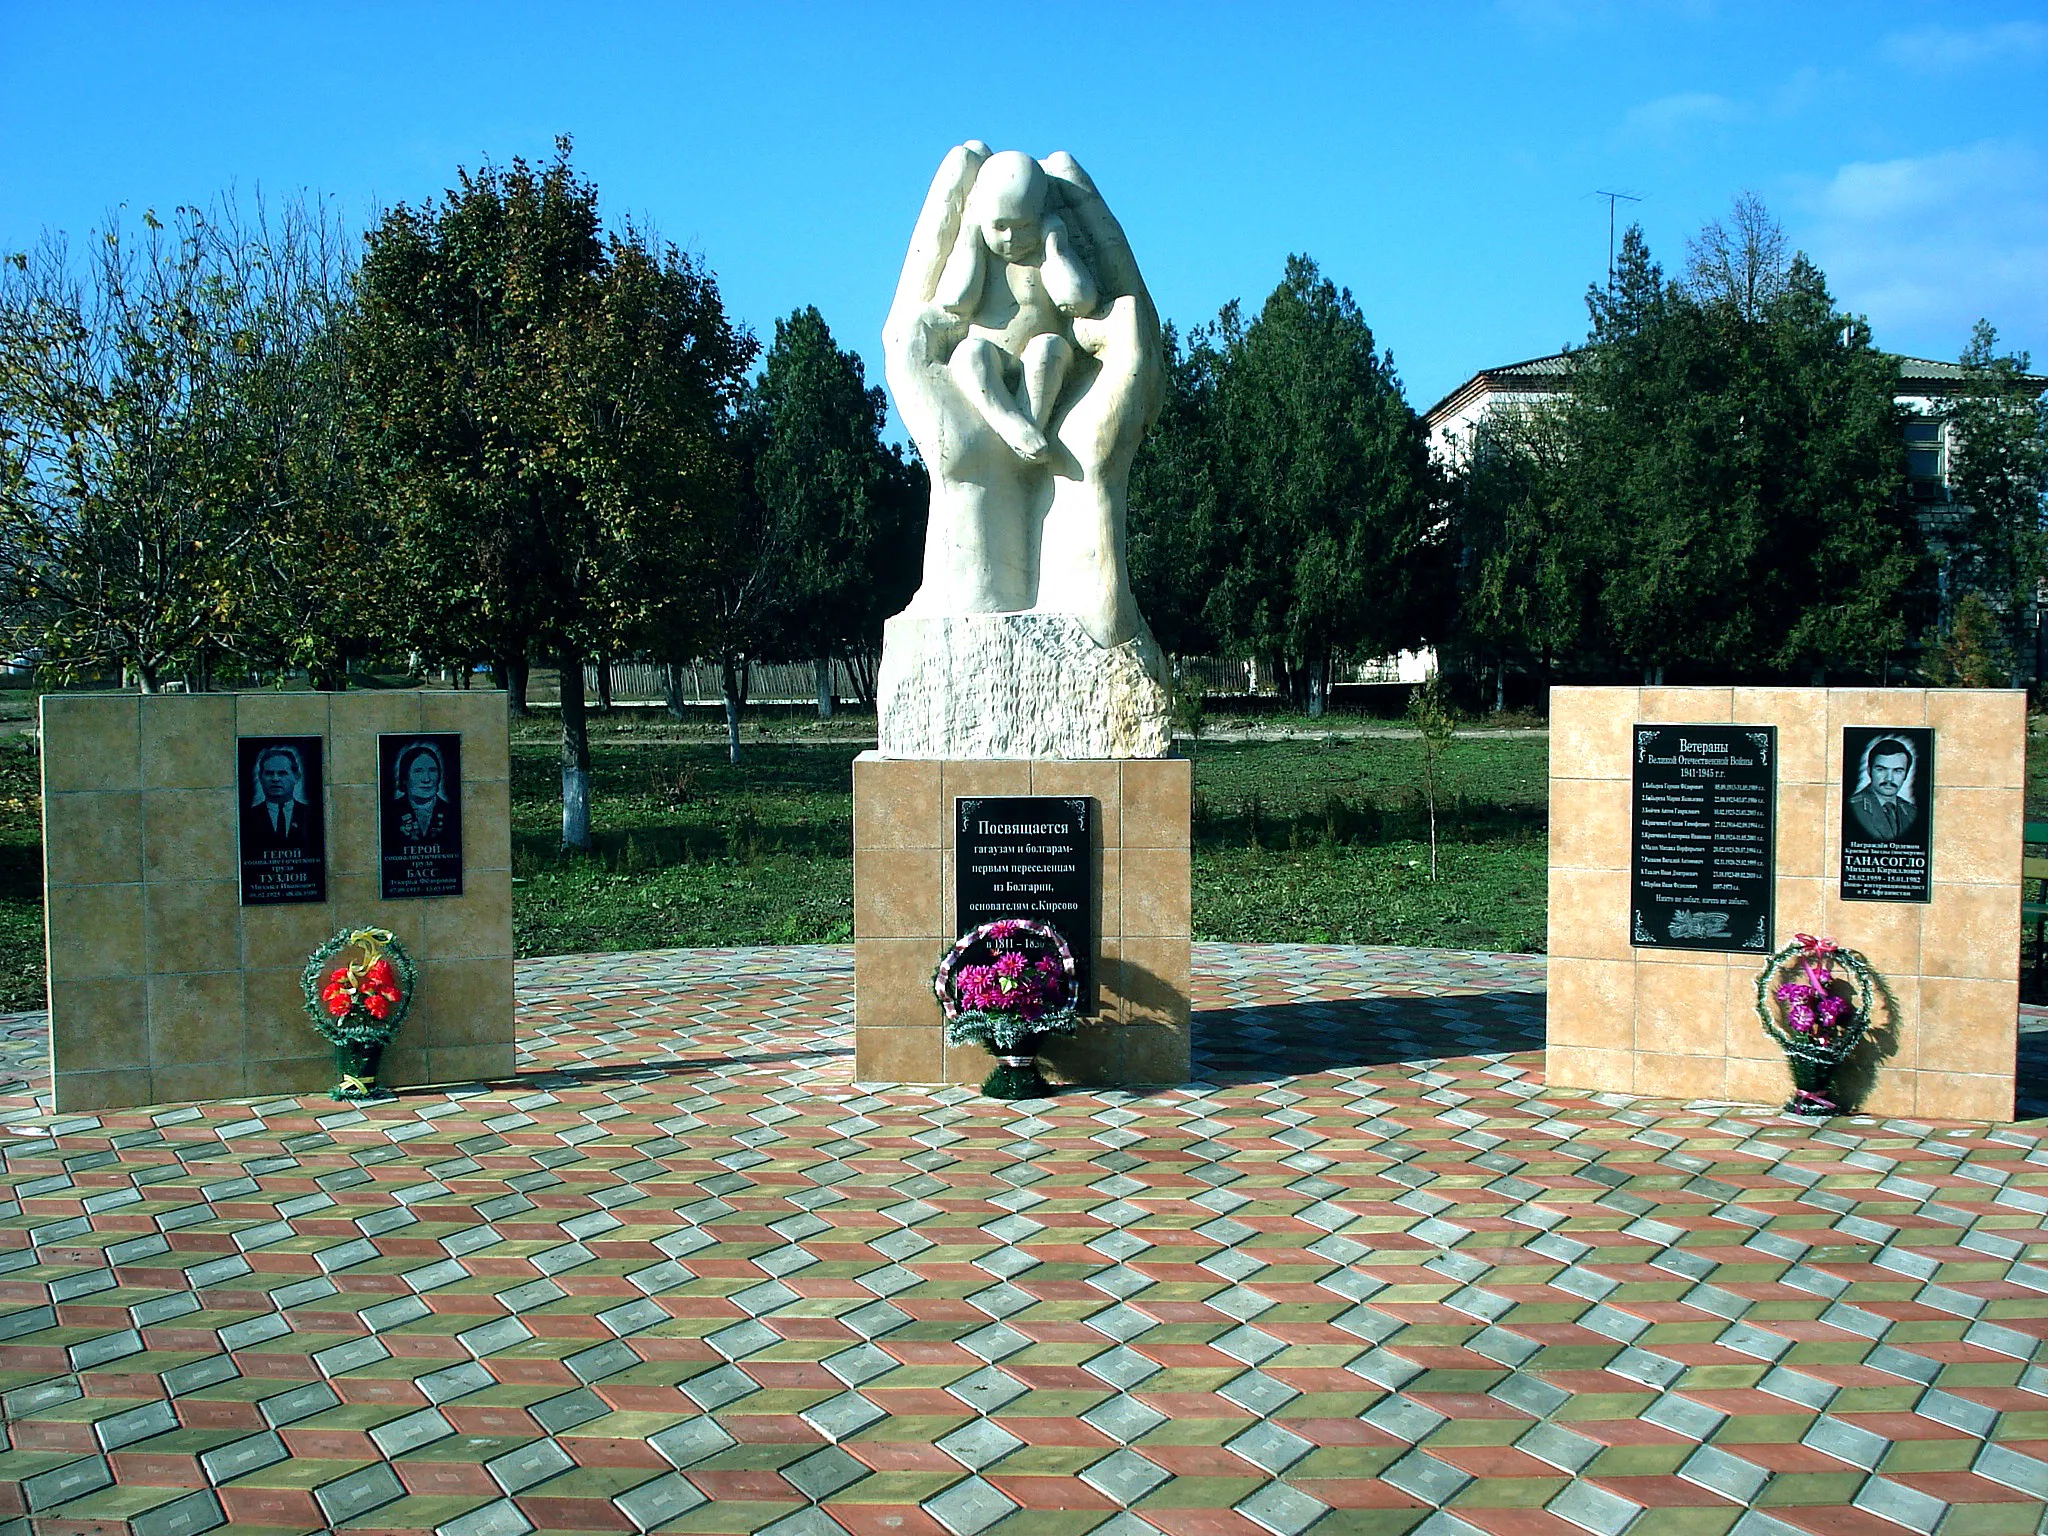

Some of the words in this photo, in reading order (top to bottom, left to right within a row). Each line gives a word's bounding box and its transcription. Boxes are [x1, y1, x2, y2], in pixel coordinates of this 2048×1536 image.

[1679, 738, 1729, 755] Ветераны
[1648, 755, 1677, 764] Великой
[1678, 755, 1729, 765] Отечественной
[1730, 756, 1753, 766] Войны
[1680, 768, 1714, 777] 1941-1945
[978, 821, 1069, 836] Посвящается
[263, 848, 302, 859] ГЕРОЙ
[403, 844, 441, 855] ГЕРОЙ
[974, 845, 1015, 855] гагаузам
[1025, 844, 1073, 855] болгарам-
[384, 853, 460, 861] социалистического
[1844, 856, 1926, 867] ТАНАСОГЛО
[407, 868, 438, 878] БАСС
[972, 865, 1009, 875] первым
[1011, 864, 1075, 875] переселенцам
[1877, 867, 1924, 875] Кириллович
[259, 873, 307, 883] ТУЗЛОВ
[1006, 882, 1054, 893] Болгарии,
[1655, 894, 1674, 902] Никто
[969, 903, 1029, 911] основателям
[1031, 900, 1078, 912] с.Кирсово
[995, 938, 1014, 948] 1811
